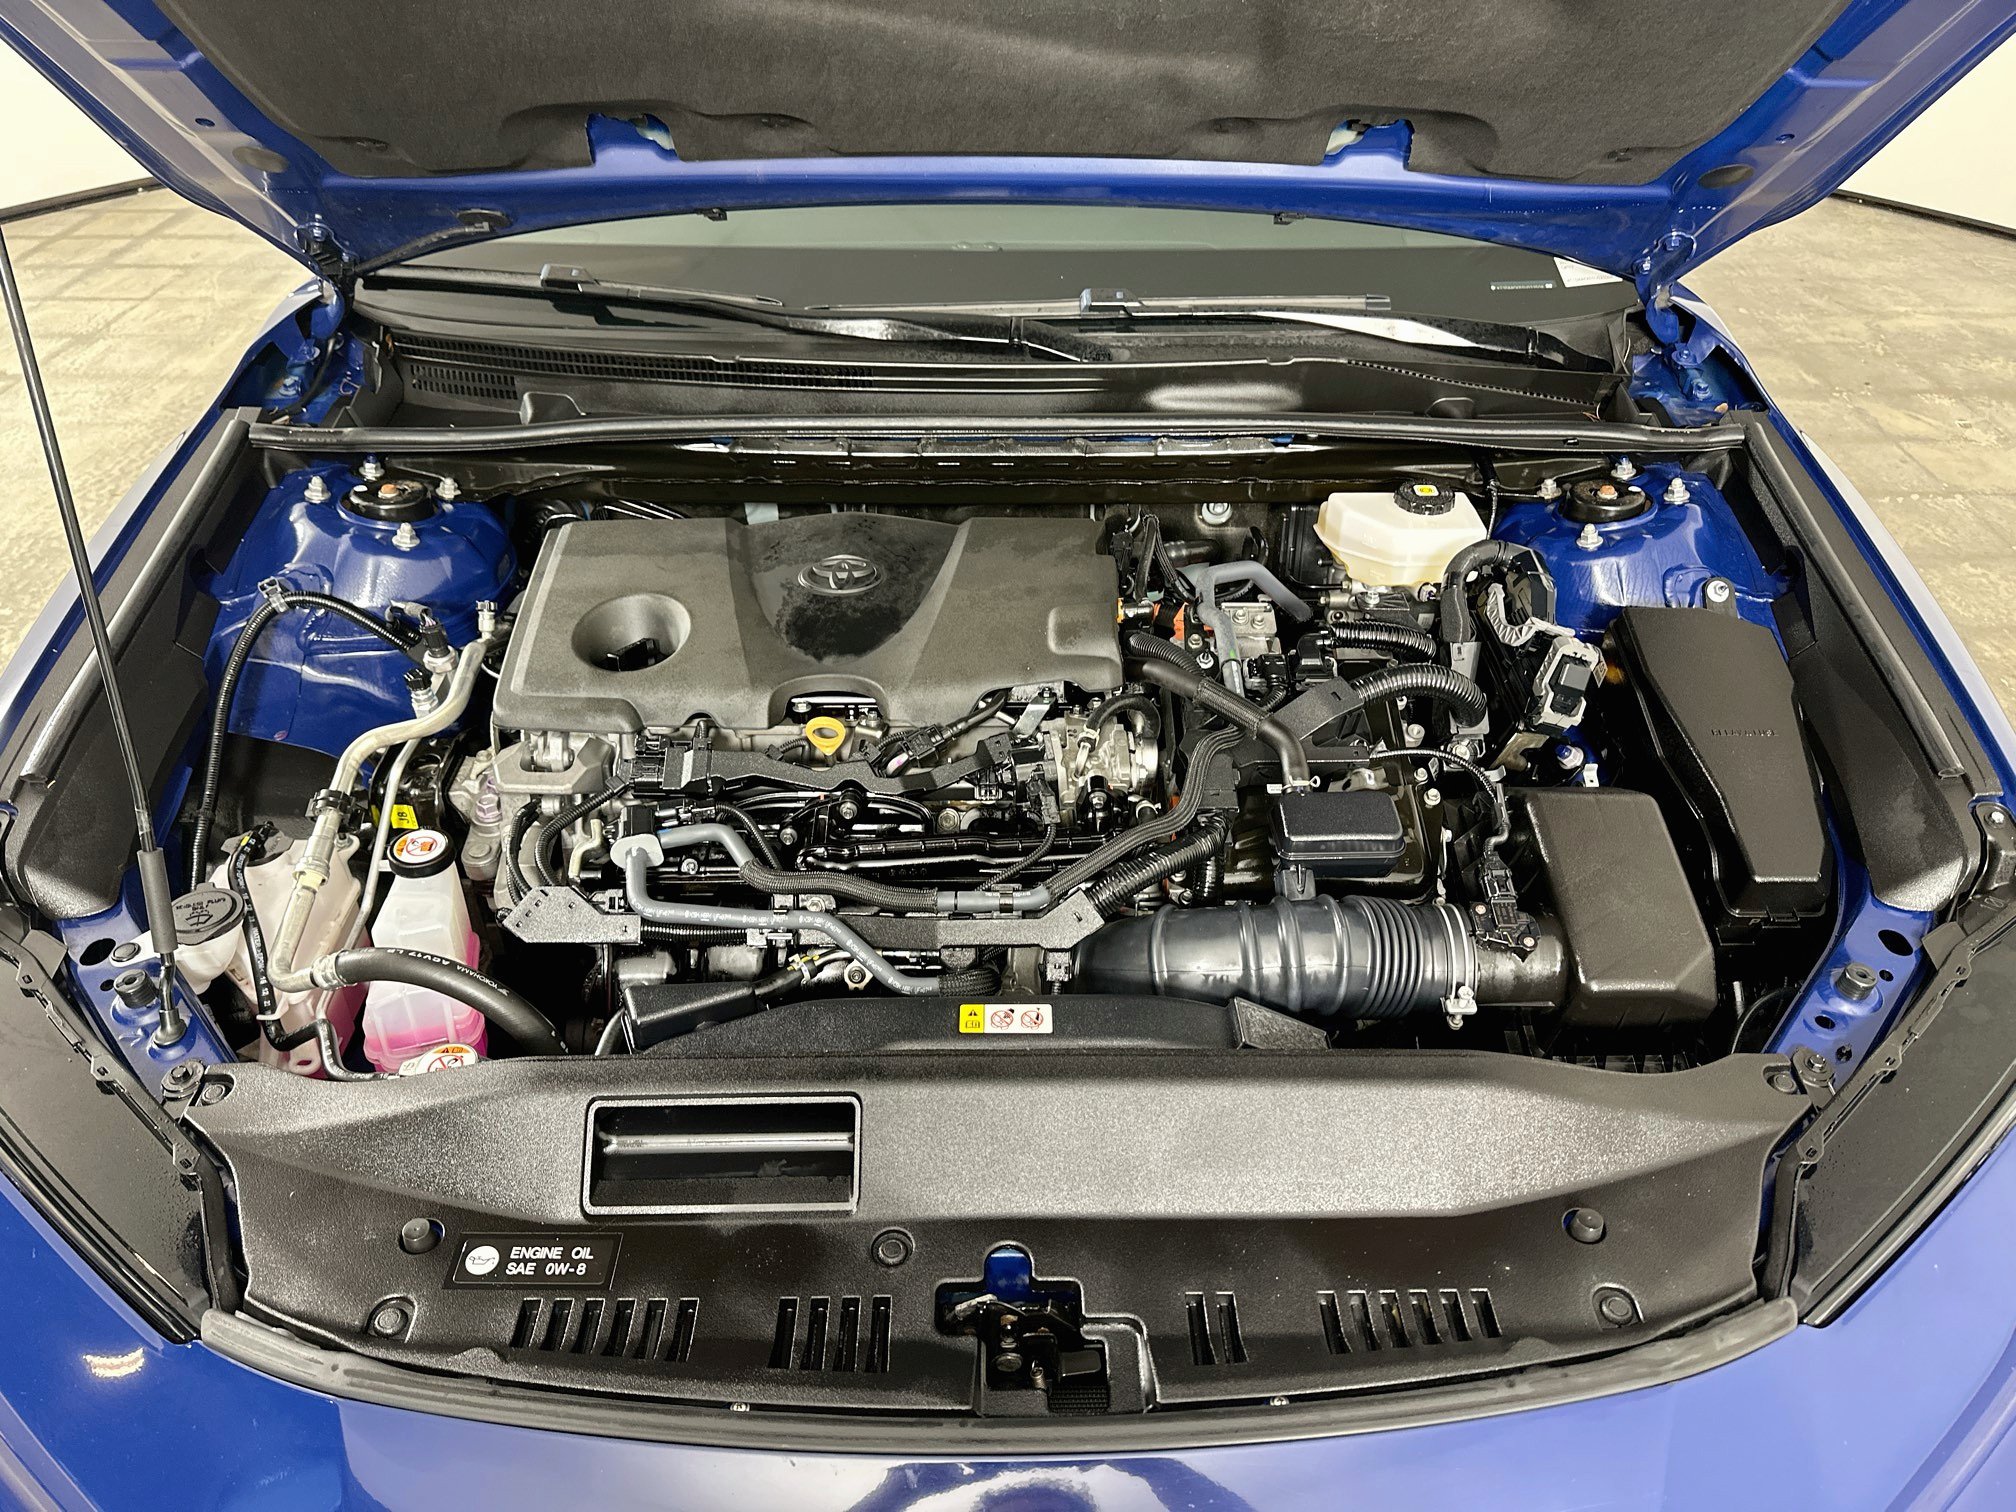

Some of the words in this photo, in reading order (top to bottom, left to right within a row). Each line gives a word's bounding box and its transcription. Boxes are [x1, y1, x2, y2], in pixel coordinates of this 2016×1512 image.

[456, 964, 498, 989] YOKOHAMA
[509, 1246, 564, 1260] ENGINE
[571, 1246, 594, 1260] OIL
[505, 1262, 537, 1276] SAE
[544, 1262, 587, 1276] 0W-8
